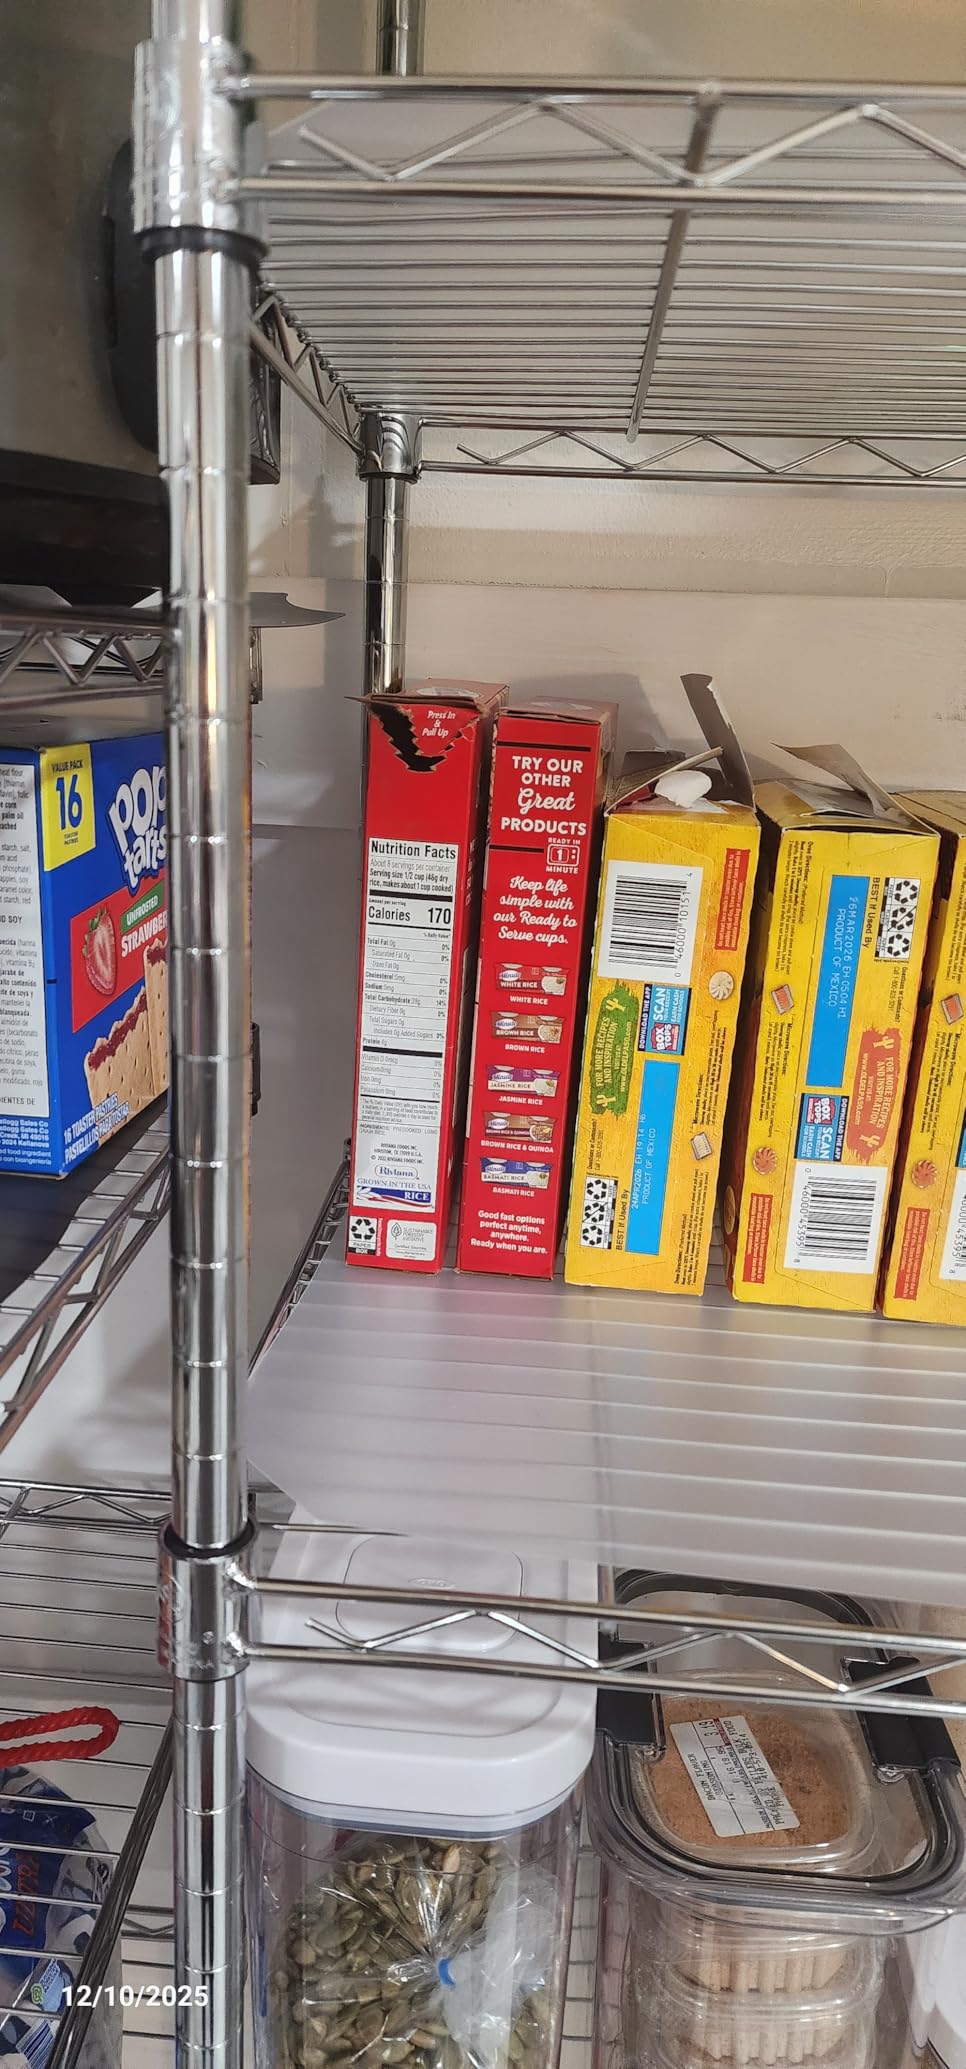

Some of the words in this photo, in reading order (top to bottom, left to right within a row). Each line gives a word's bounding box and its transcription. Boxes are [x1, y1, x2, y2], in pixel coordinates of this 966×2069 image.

[427, 710, 445, 720] Press
[446, 711, 456, 720] In
[434, 720, 441, 728] &
[422, 727, 436, 736] Pull
[437, 728, 449, 738] Up
[52, 761, 69, 773] VALUE
[70, 760, 83, 770] PACK
[512, 756, 542, 771] TRY
[547, 758, 583, 773] OUR
[521, 773, 571, 787] OTHER
[56, 774, 82, 830] 16
[518, 788, 575, 814] Great
[501, 817, 586, 836] PRODUCTS
[371, 840, 420, 856] Nutrition
[425, 845, 456, 859] Facts
[548, 837, 570, 845] READY
[556, 849, 563, 860] 1
[370, 859, 386, 867] About
[392, 862, 414, 872] servings
[416, 863, 424, 872] per
[425, 864, 450, 872] container
[546, 865, 579, 874] MINUTE
[370, 868, 390, 879] Serving
[392, 870, 403, 878] size
[405, 871, 413, 880] 1/2
[414, 874, 424, 882] cup
[426, 873, 438, 883] (46g
[439, 874, 448, 884] dry
[510, 876, 543, 894] Keep
[546, 879, 568, 895] life
[370, 879, 382, 887] rice,
[383, 880, 400, 888] makes
[401, 882, 416, 890] about
[432, 884, 453, 894] cooked)
[871, 877, 880, 901] BEST
[126, 896, 158, 926] UNFROSTED
[499, 895, 543, 911] simple
[544, 897, 574, 911] with
[679, 890, 691, 921] 10151
[871, 902, 877, 910] If
[9, 916, 22, 924] SOY
[368, 906, 411, 921] Calories
[428, 908, 451, 924] 170
[493, 912, 516, 922] our
[519, 911, 560, 930] Ready
[563, 917, 577, 927] to
[866, 912, 875, 934] Used
[498, 926, 533, 941] Serve
[535, 930, 568, 947] cups.
[834, 908, 846, 952] PRODUCT
[843, 896, 858, 961] 26MAR2026
[675, 927, 687, 960] 46000
[862, 936, 872, 949] By
[833, 956, 841, 968] OF
[842, 966, 851, 977] EH
[828, 972, 840, 1007] MEXICO
[510, 996, 531, 1004] WHITE
[533, 997, 548, 1005] RICE
[653, 988, 666, 1020] SCAN
[639, 1012, 649, 1049] DOWNLOAD
[644, 987, 652, 1000] APP
[597, 1017, 610, 1048] RECIPES
[656, 1028, 665, 1050] BOX
[505, 1044, 529, 1052] BROWN
[604, 1022, 618, 1067] INSPIRATION
[595, 1050, 603, 1073] MORE
[620, 1022, 632, 1093] www.OLDELPASO.com
[886, 1057, 894, 1070] FOR
[604, 1069, 612, 1083] AND
[877, 1061, 885, 1075] AND
[596, 1074, 604, 1086] FOR
[855, 1053, 869, 1125] www.OLDELPASO.com
[884, 1072, 894, 1096] MORE
[499, 1096, 526, 1104] JASMINE
[821, 1098, 831, 1120] BOX
[869, 1078, 885, 1125] INSPIRATION
[64, 1128, 71, 1145] 16
[72, 1110, 95, 1139] TOASTER
[96, 1092, 118, 1121] PASTRIES
[814, 1101, 822, 1124] TOPS
[838, 1098, 848, 1134] DOWNLOAD
[877, 1098, 892, 1128] RECIPES
[65, 1126, 99, 1164] PASTELILLOS
[100, 1116, 112, 1137] PARA
[480, 1140, 505, 1149] BROWN
[506, 1142, 521, 1150] RICE
[528, 1145, 554, 1153] QUINOA
[647, 1128, 656, 1156] MEXICO
[822, 1127, 833, 1159] SCAN
[836, 1135, 844, 1146] THE
[635, 1152, 642, 1164] EH
[646, 1159, 652, 1169] OF
[357, 1178, 387, 1186] GROWN
[492, 1187, 519, 1196] BASMATI
[631, 1168, 642, 1209] 24APR2026
[642, 1173, 652, 1205] PRODUCT
[404, 1191, 430, 1201] RICE
[800, 1185, 811, 1214] 46000
[478, 1210, 498, 1220] Good
[500, 1212, 514, 1221] fast
[516, 1214, 545, 1225] options
[616, 1229, 624, 1250] BEST
[622, 1189, 630, 1200] By
[480, 1221, 507, 1231] perfect
[508, 1224, 542, 1234] anytime,
[490, 1231, 529, 1242] anywhere.
[796, 1218, 807, 1247] 45395
[471, 1238, 494, 1249] Ready
[496, 1241, 516, 1250] when
[518, 1245, 532, 1253] you
[533, 1246, 548, 1254] are.
[952, 1228, 964, 1258] 45395
[699, 1720, 719, 1736] 3.19
[722, 1720, 738, 1736] FOOD
[700, 1780, 716, 1800] BACON
